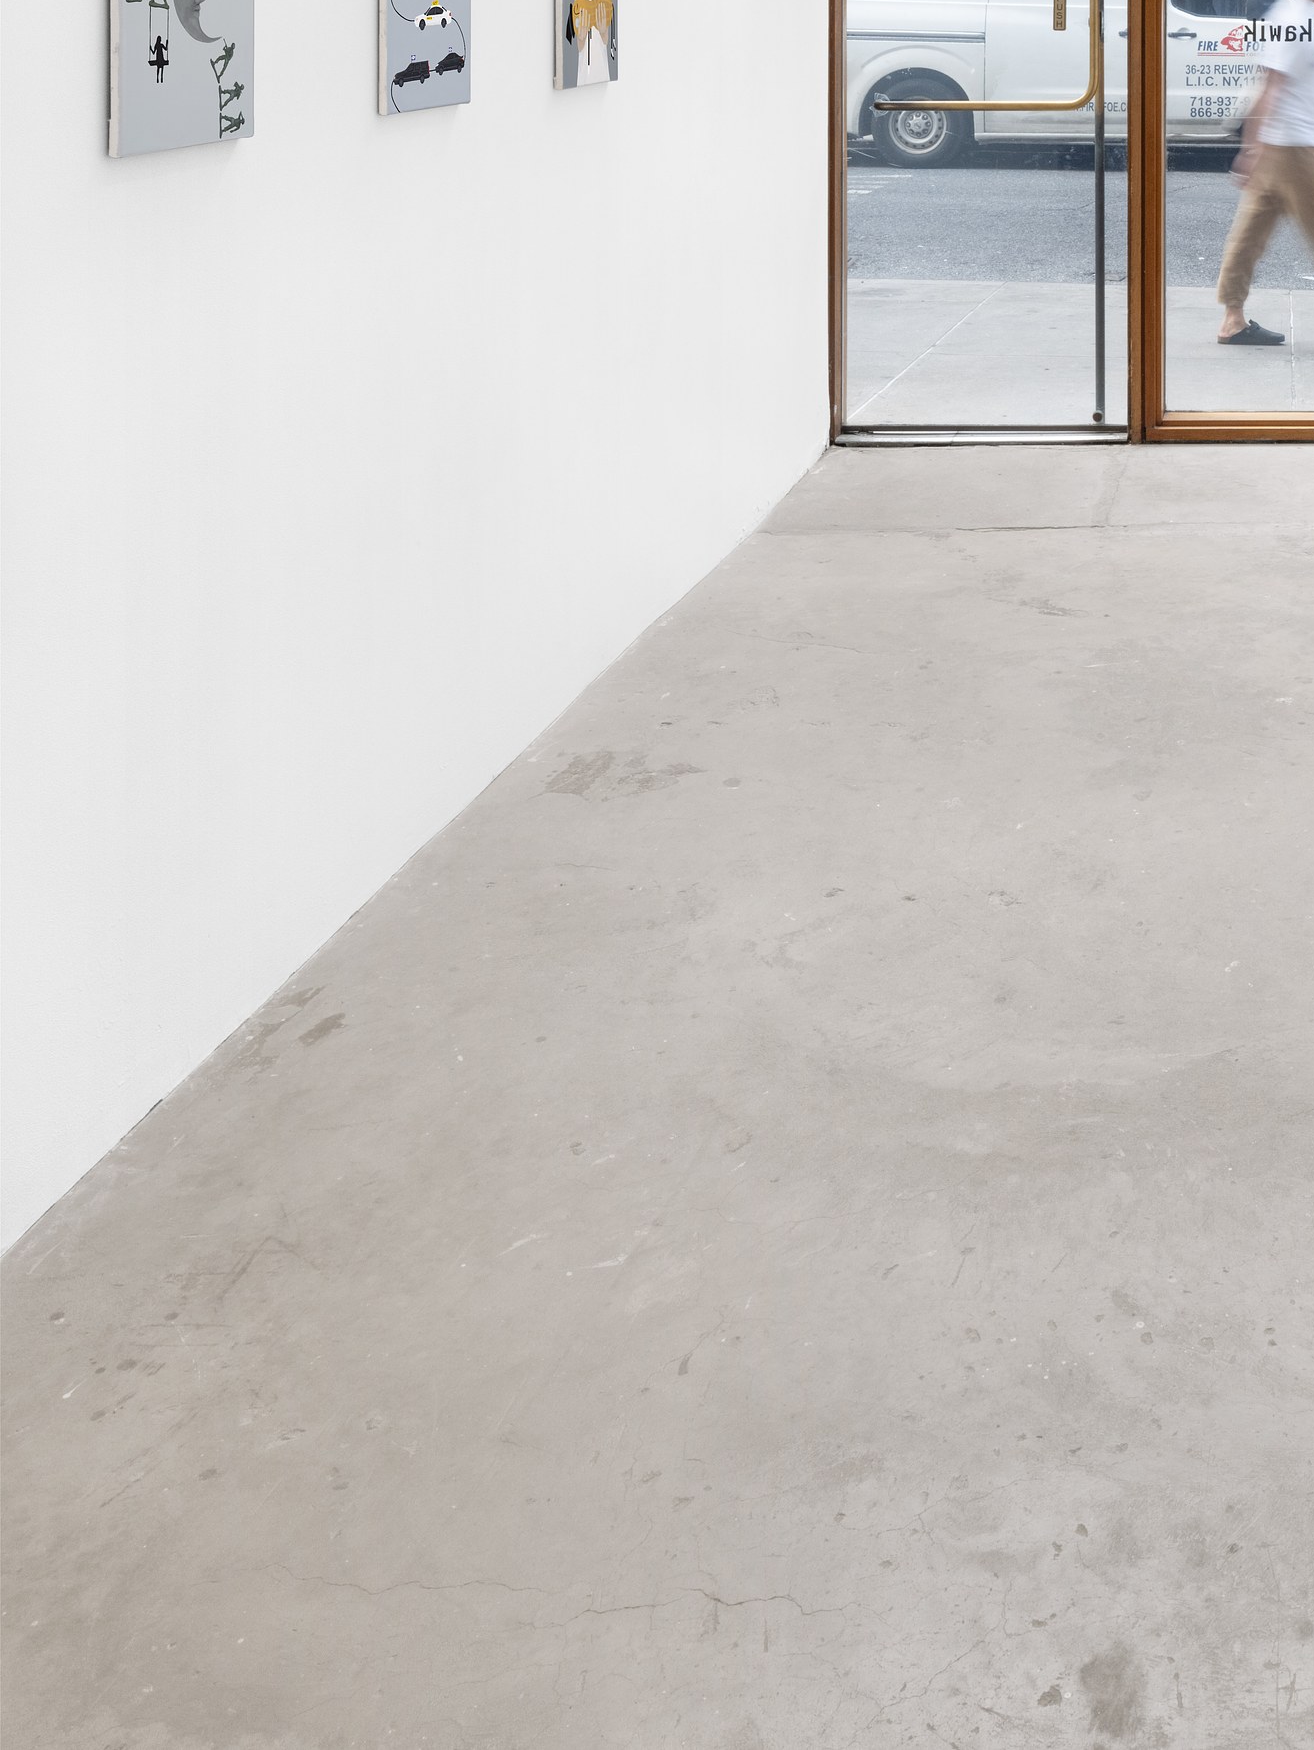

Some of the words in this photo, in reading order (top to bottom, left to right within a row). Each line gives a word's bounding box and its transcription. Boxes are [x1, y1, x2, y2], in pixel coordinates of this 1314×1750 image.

[1197, 41, 1219, 52] FIRE
[1185, 64, 1211, 75] 36-23
[1214, 64, 1254, 75] REVIEW
[1185, 76, 1218, 87] L.I.C.
